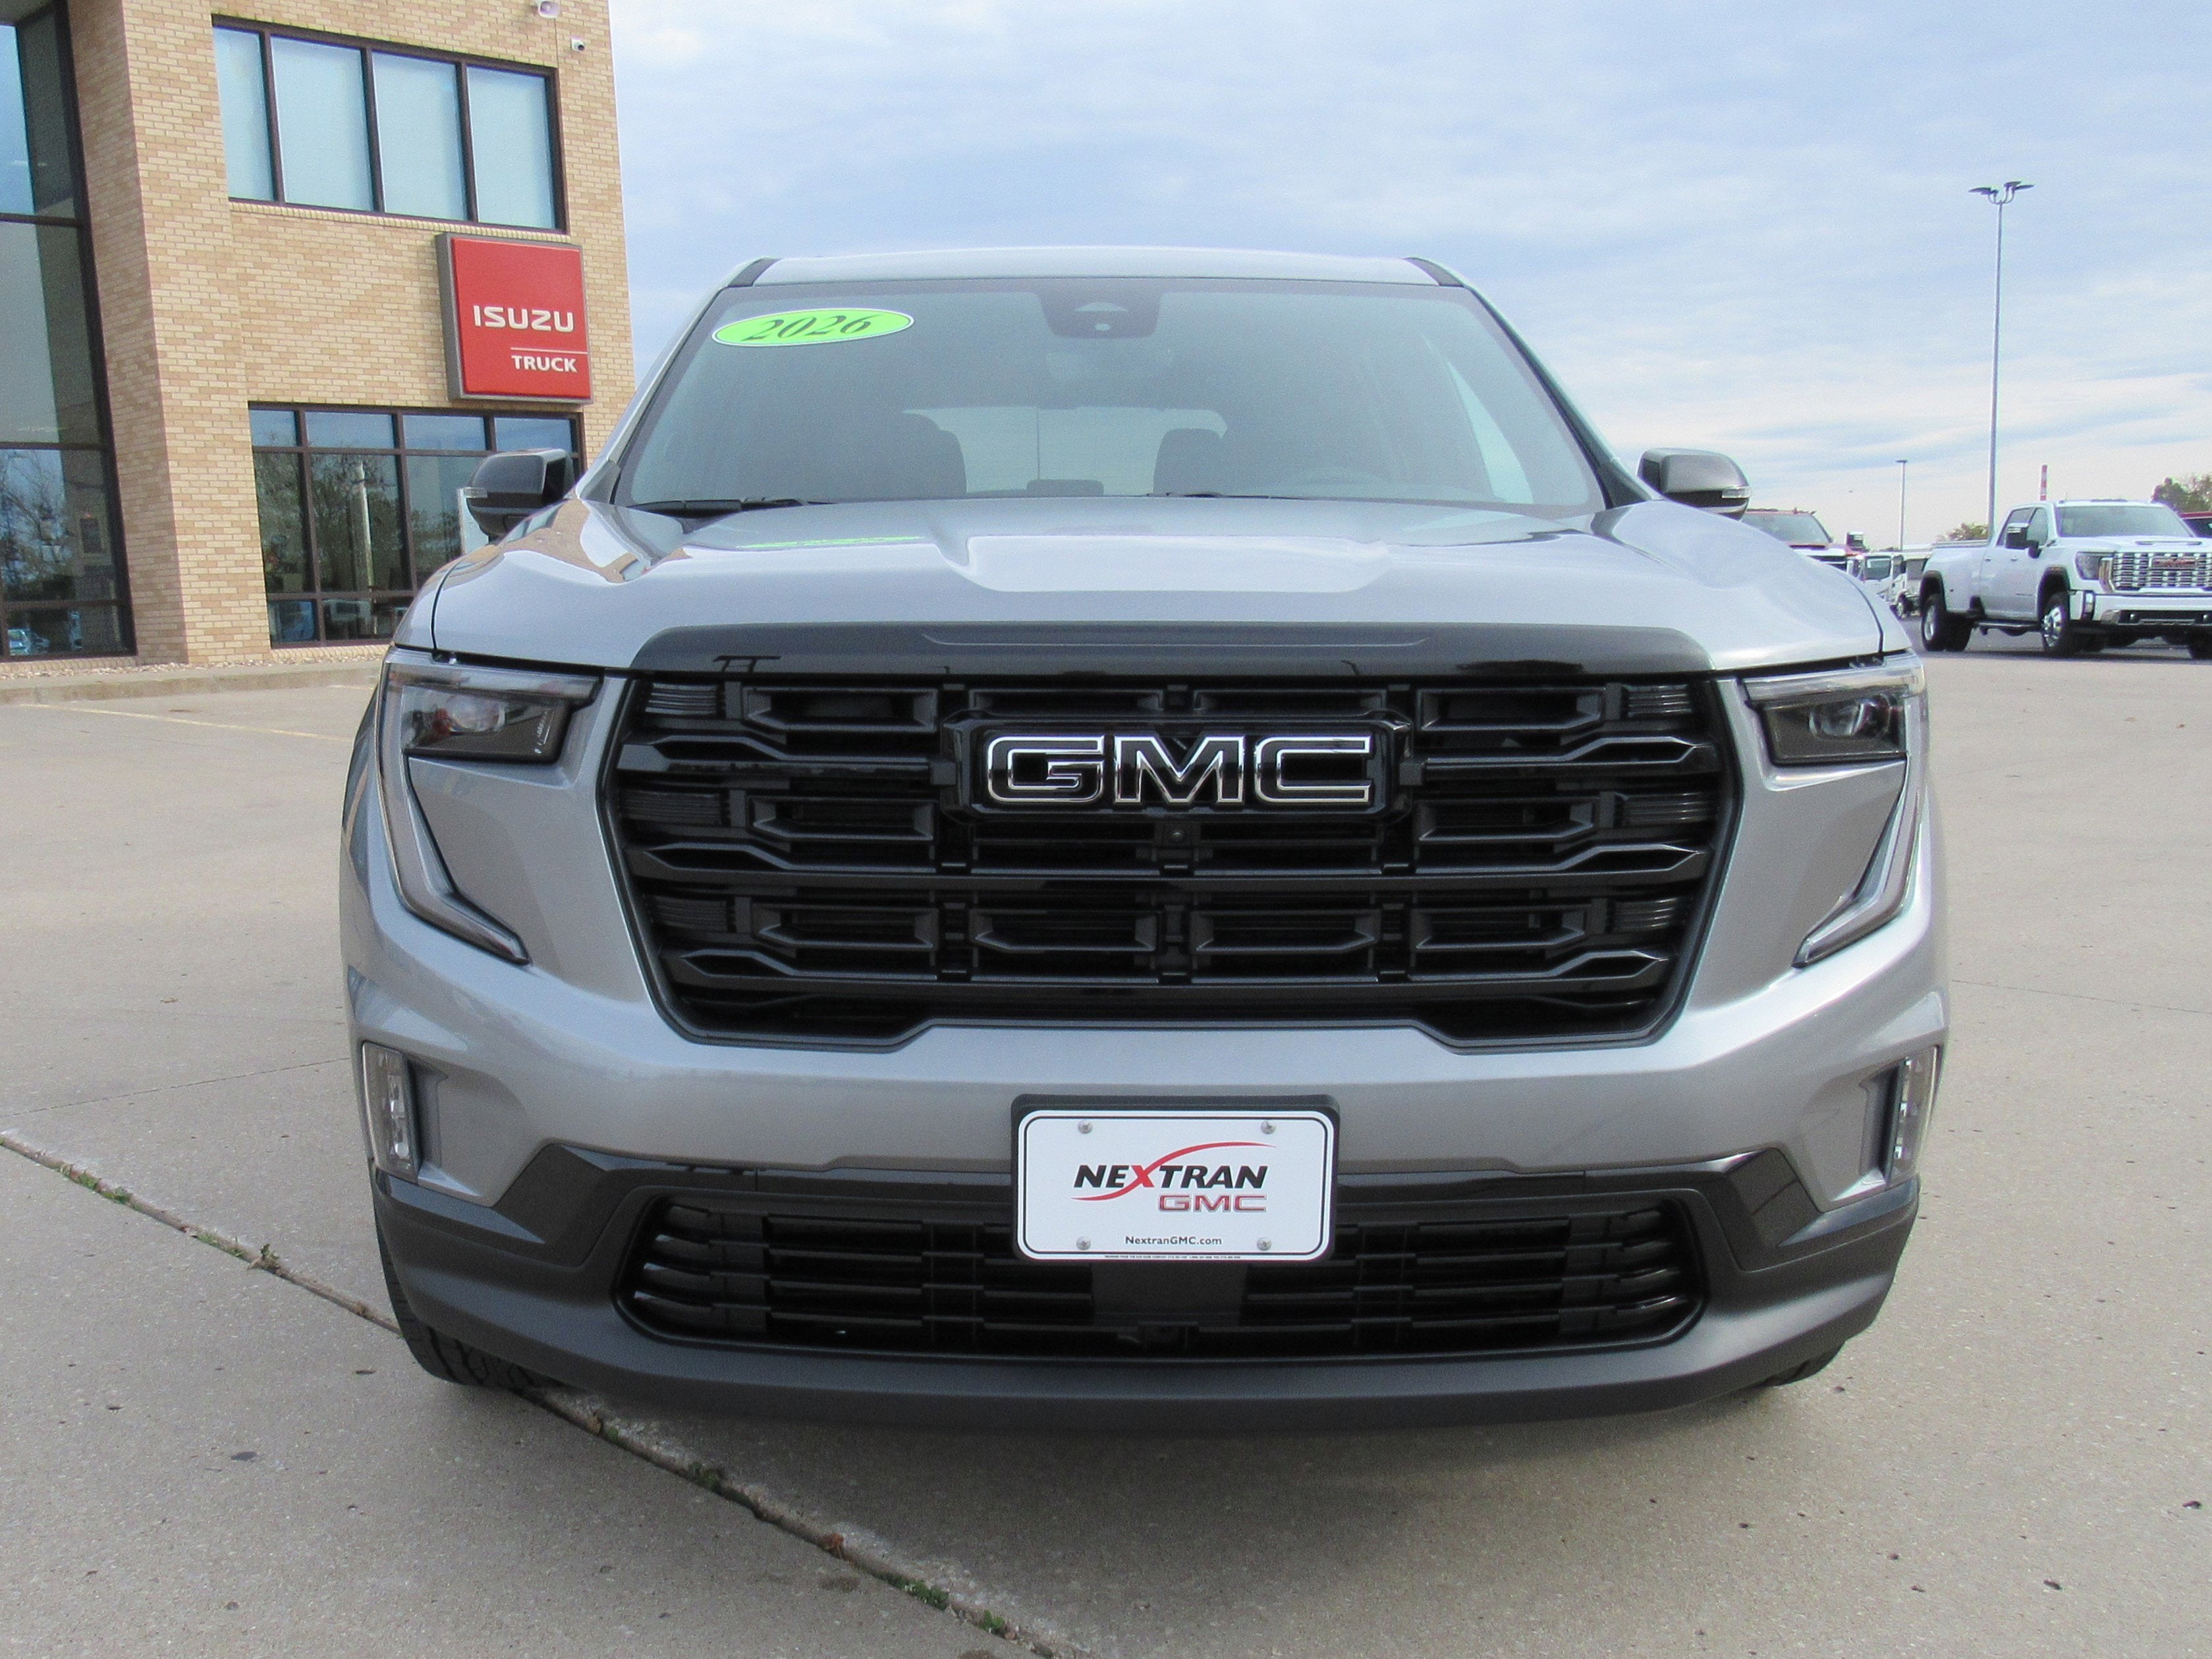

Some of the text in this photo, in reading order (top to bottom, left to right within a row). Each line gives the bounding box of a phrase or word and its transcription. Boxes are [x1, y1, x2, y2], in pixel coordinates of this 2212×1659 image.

[473, 305, 574, 333] ISUZU
[740, 313, 885, 342] 2026
[511, 355, 578, 372] TRUCK
[987, 734, 1371, 803] GMC
[1073, 1164, 1269, 1189] NEXTRAN
[1157, 1193, 1267, 1212] GMC
[1125, 1236, 1223, 1245] NextranGMC.com
